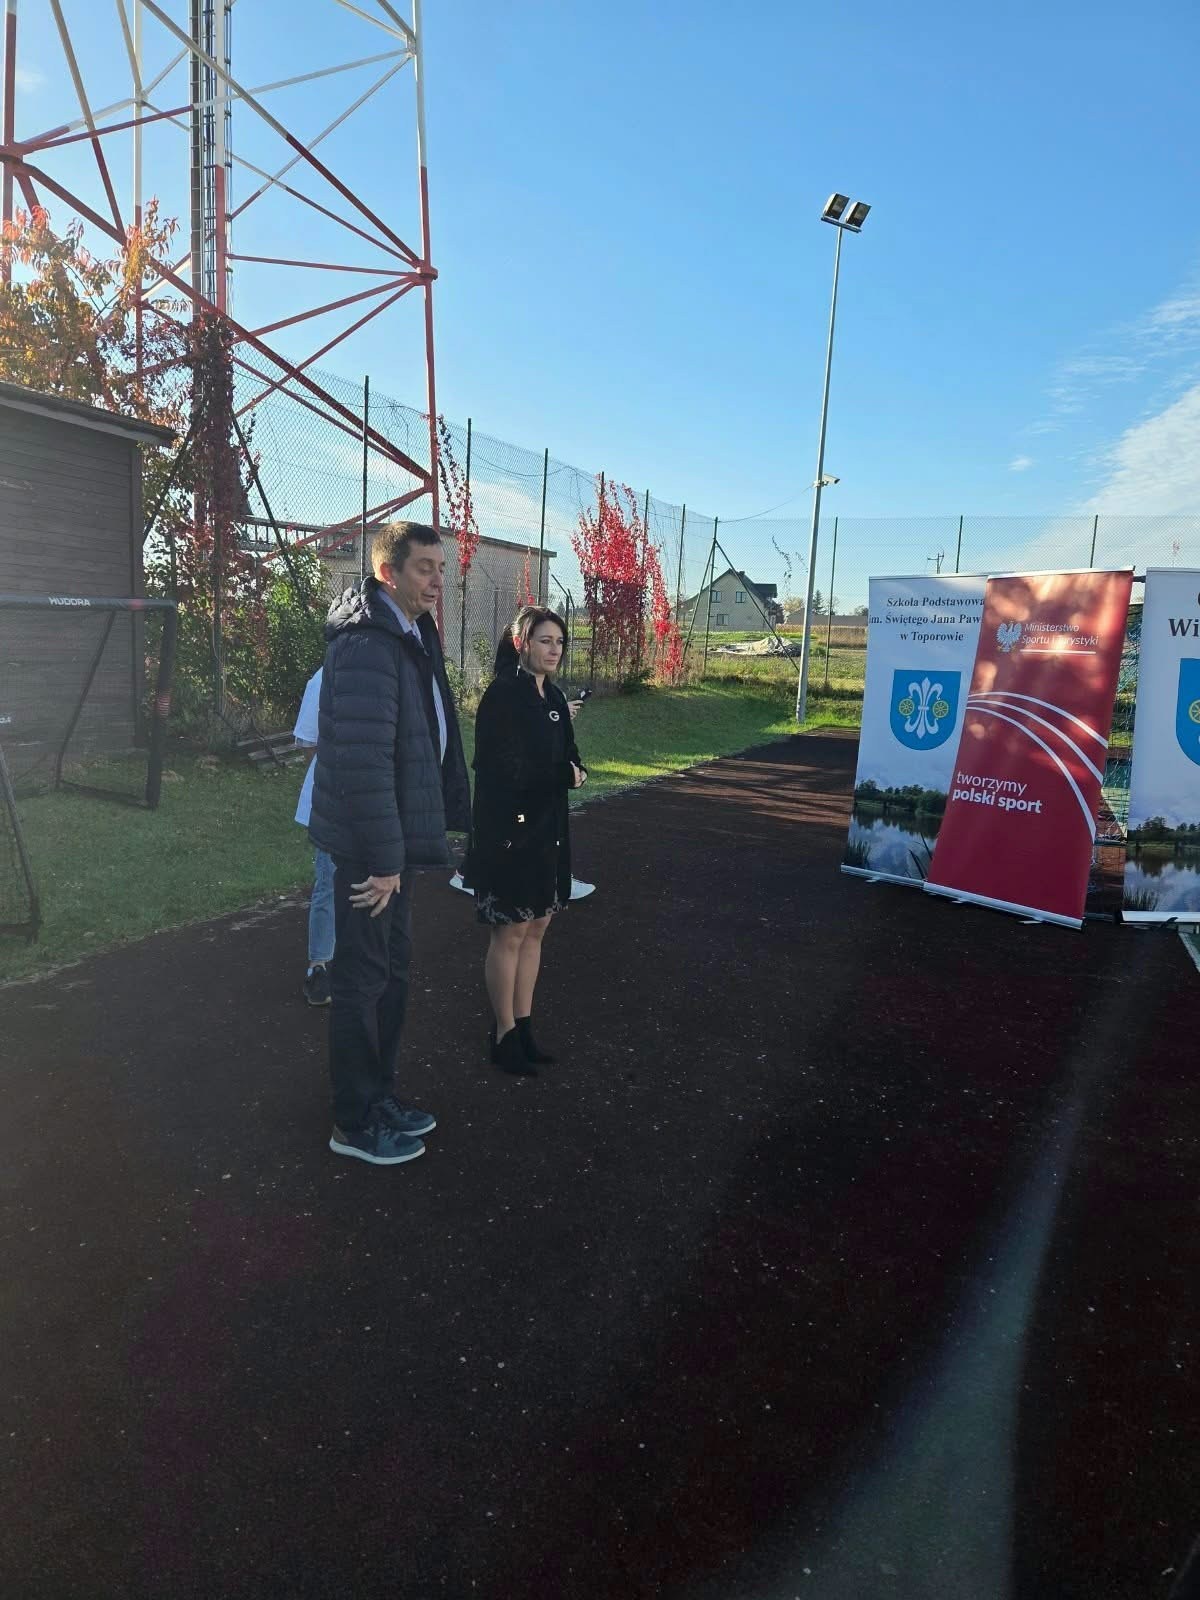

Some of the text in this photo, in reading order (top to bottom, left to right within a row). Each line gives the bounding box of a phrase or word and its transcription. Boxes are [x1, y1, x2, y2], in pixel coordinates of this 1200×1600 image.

[885, 611, 928, 626] Świętego
[930, 614, 955, 624] Jana
[958, 614, 983, 624] Paw
[1024, 622, 1079, 632] Ministerstwo
[900, 631, 964, 644] w Toporowie
[1021, 634, 1050, 645] Sportu
[1056, 634, 1099, 647] rystyki
[956, 771, 1028, 797] tworzymy
[952, 787, 1042, 814] polski sport
